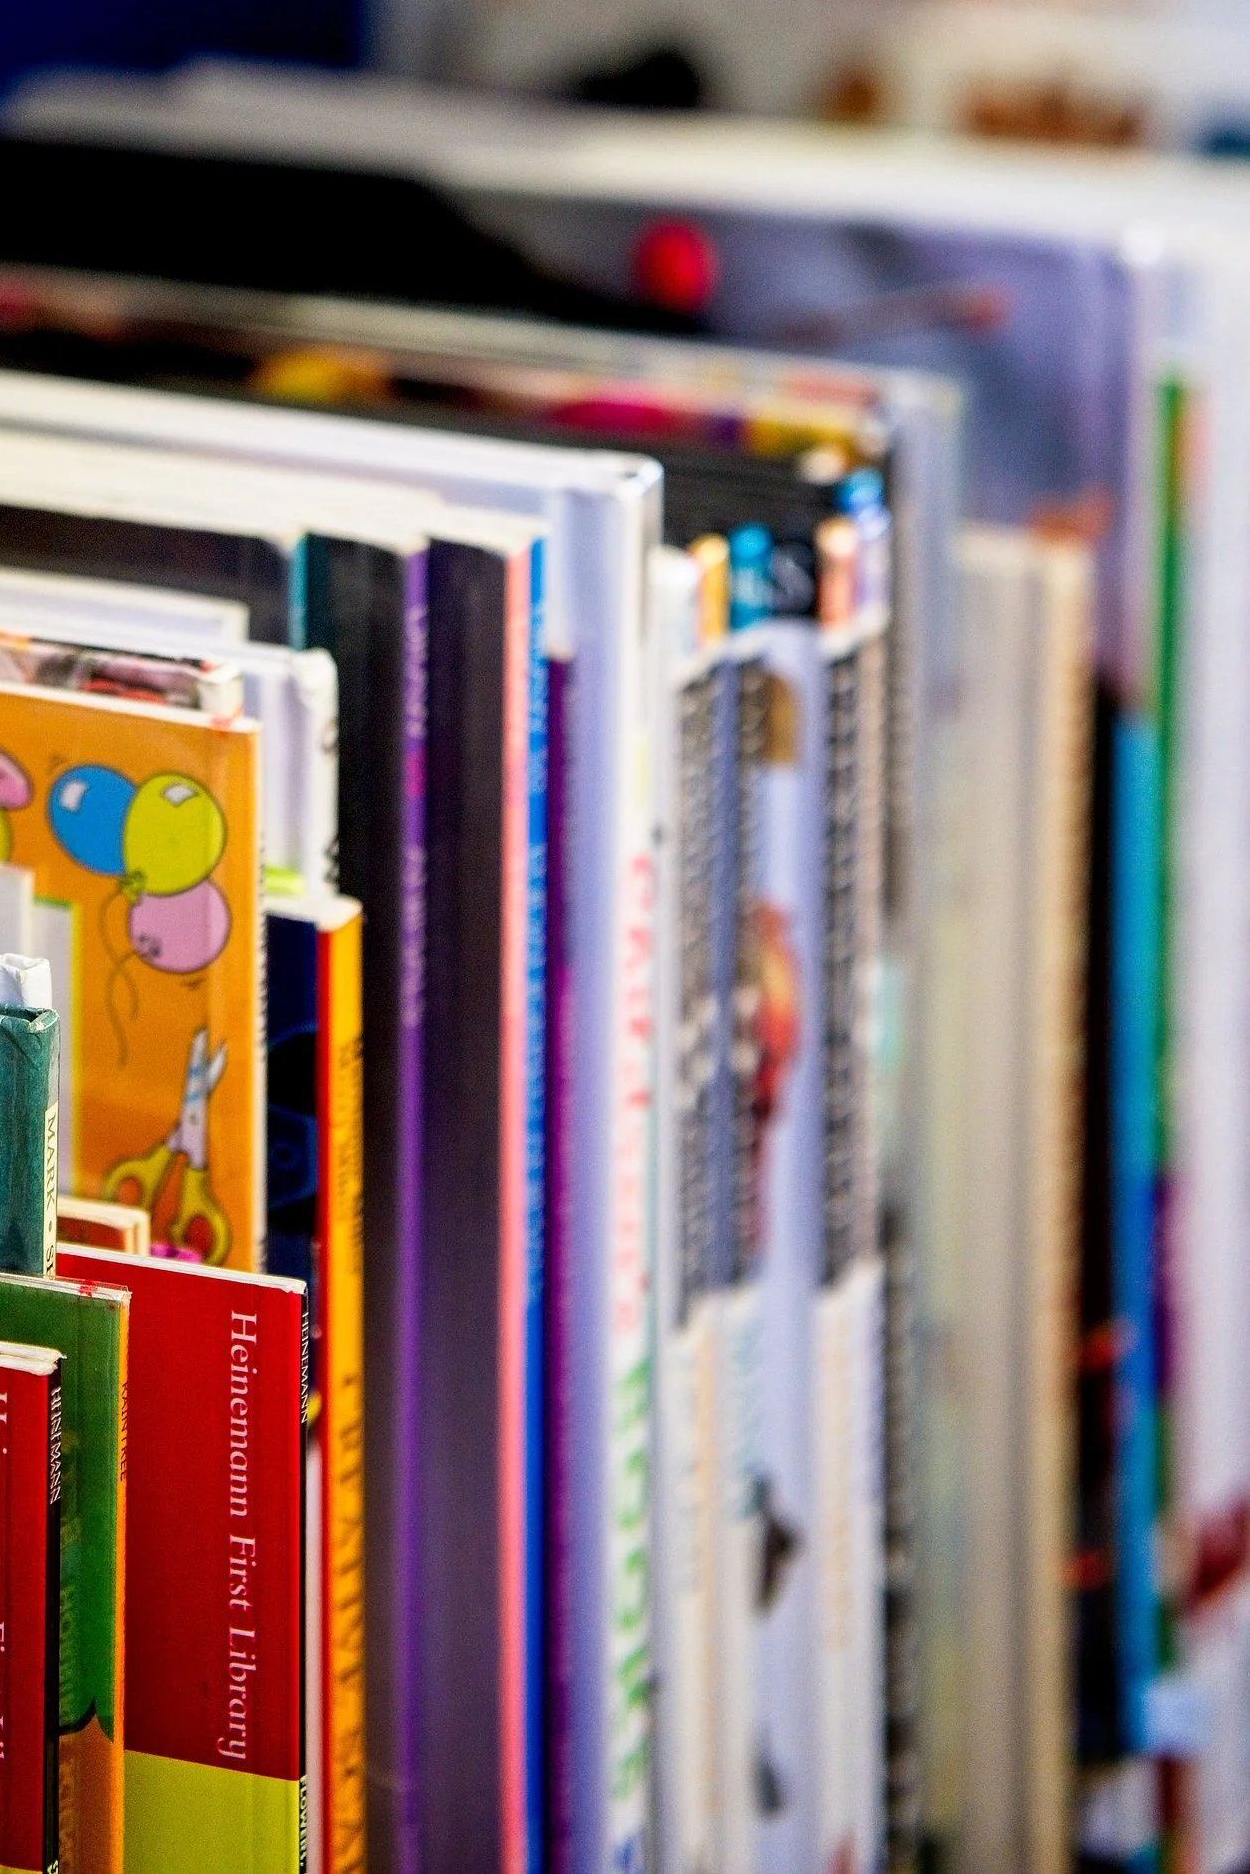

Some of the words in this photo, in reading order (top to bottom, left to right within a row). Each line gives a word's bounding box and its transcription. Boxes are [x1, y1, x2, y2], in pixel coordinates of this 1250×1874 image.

[46, 1111, 57, 1212] MARK
[229, 1309, 258, 1518] Heinemann
[301, 1311, 309, 1424] HEINEMANN
[50, 1386, 62, 1505] HEINEMANN
[229, 1534, 257, 1612] First
[216, 1626, 258, 1760] Library
